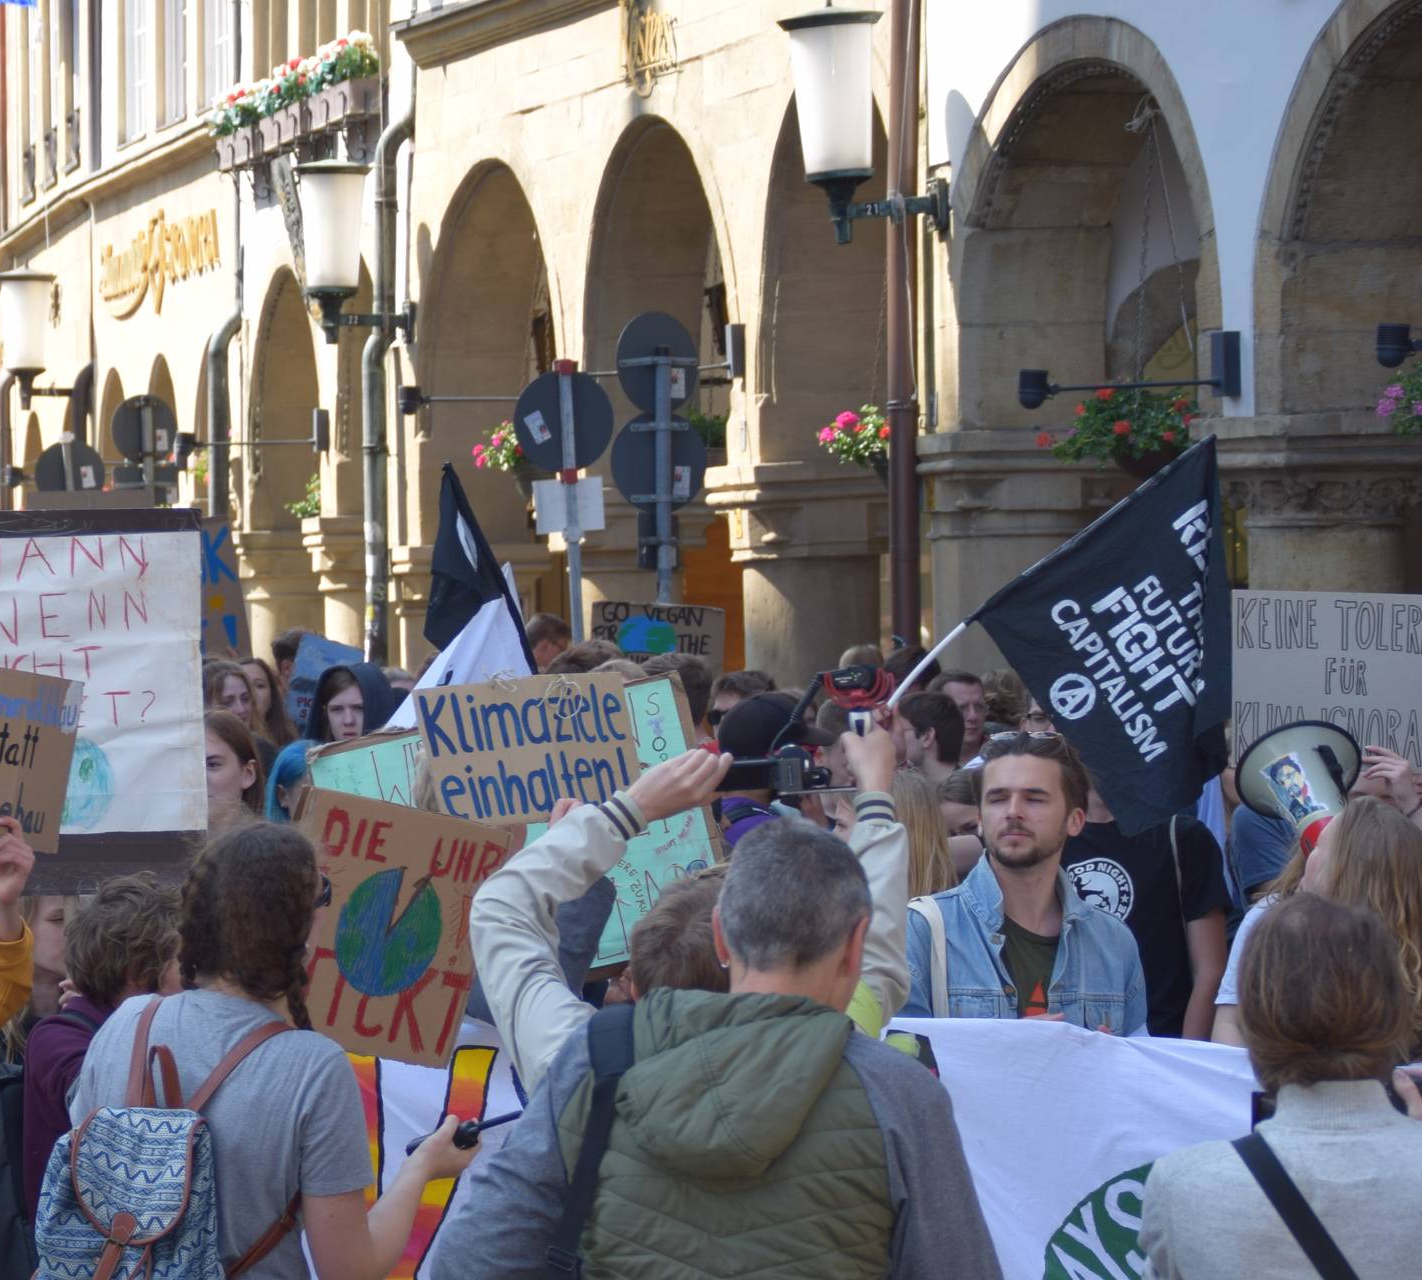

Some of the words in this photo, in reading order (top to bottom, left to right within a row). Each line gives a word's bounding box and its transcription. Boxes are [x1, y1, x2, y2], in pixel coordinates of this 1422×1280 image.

[866, 203, 879, 216] 21
[601, 601, 630, 623] GO
[643, 604, 705, 627] VEGAN
[1236, 598, 1319, 649] KEINE
[676, 634, 712, 656] THE
[1090, 586, 1196, 712] FIGHT
[1050, 599, 1169, 763] CAPITALISM
[1324, 657, 1368, 697] FÜR
[419, 684, 626, 757] Klimaziele
[440, 749, 630, 820] einhalten!
[322, 807, 394, 864] DIE
[429, 836, 508, 883] UHR
[1096, 861, 1130, 893] NIGHT
